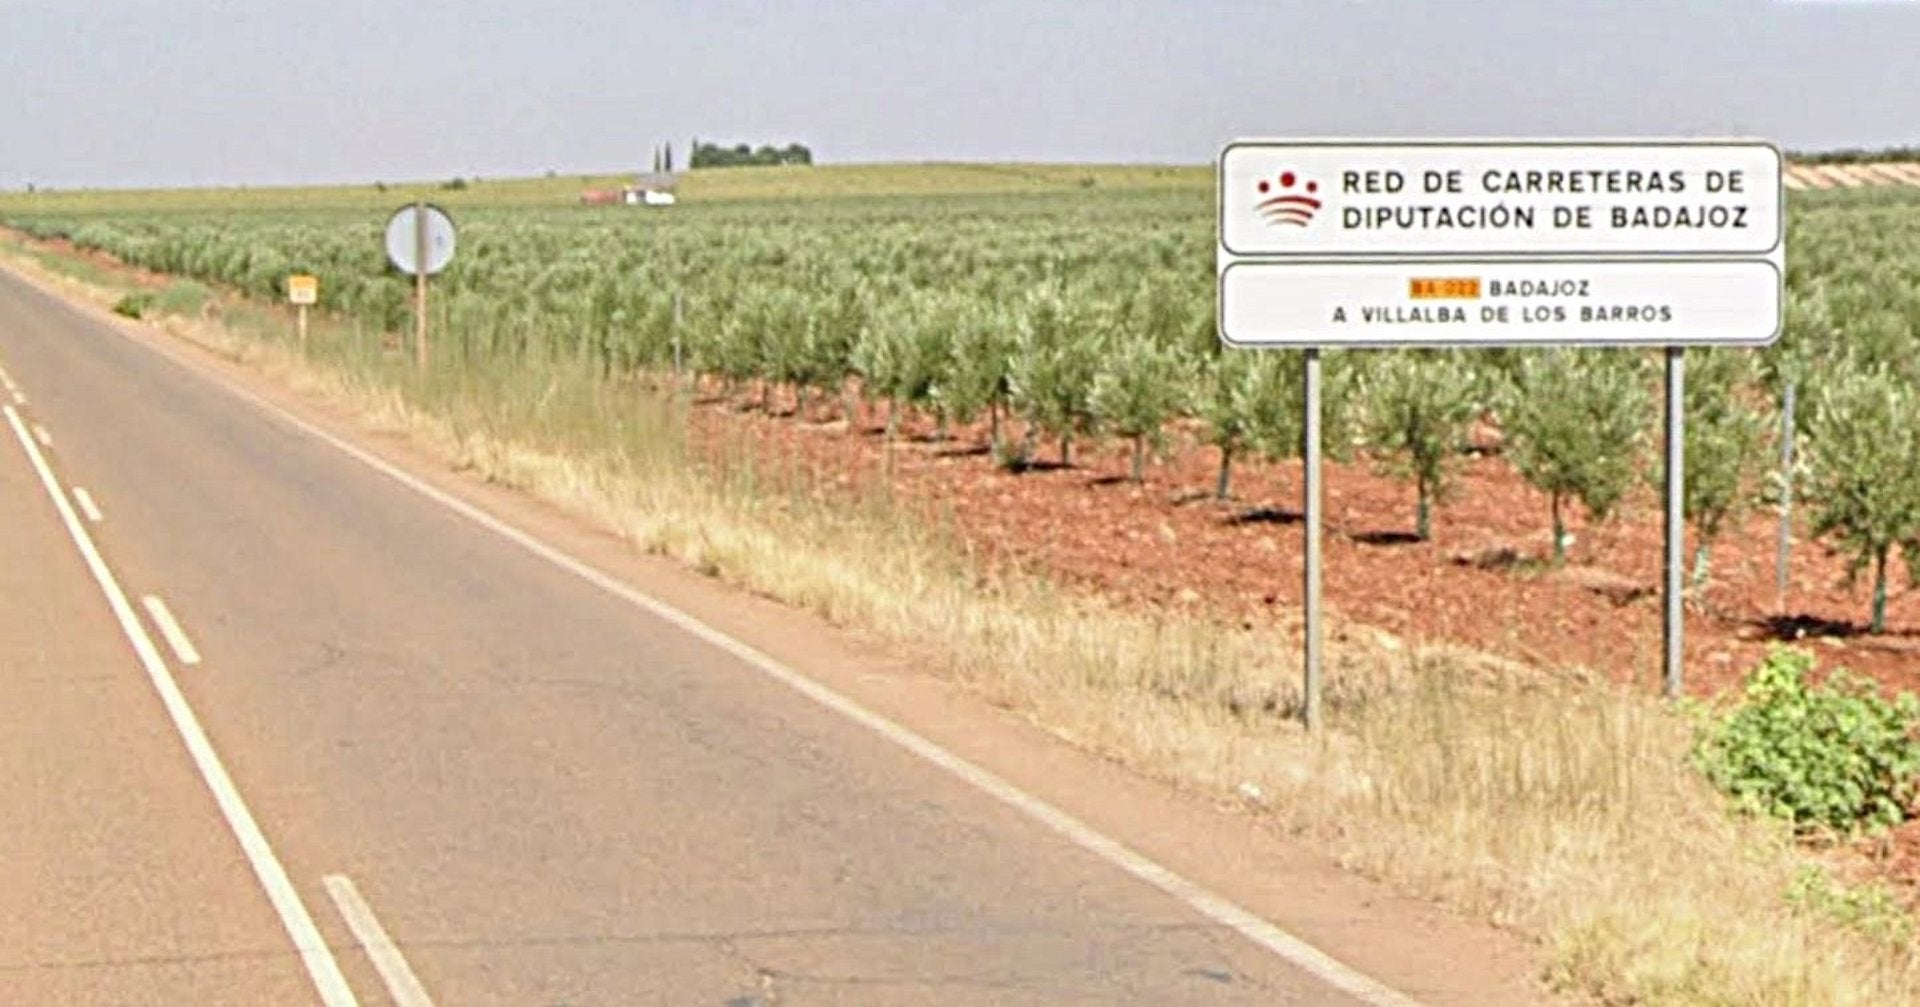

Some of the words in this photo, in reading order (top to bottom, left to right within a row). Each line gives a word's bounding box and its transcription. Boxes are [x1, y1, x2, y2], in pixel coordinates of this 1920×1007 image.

[1343, 170, 1405, 194] RED
[1423, 170, 1462, 194] DE
[1481, 169, 1686, 194] CARRETERAS
[1705, 170, 1744, 193] DE
[1343, 203, 1535, 230] DIPUTACIÓN
[1553, 206, 1592, 229] DE
[1611, 205, 1748, 229] BADAJOZ
[1489, 279, 1589, 298] BADAJOZ
[1332, 306, 1347, 323] A
[1361, 306, 1466, 324] VILLALBA
[1480, 306, 1508, 323] DE
[1522, 305, 1567, 323] LOS
[1580, 304, 1672, 323] BARROS
